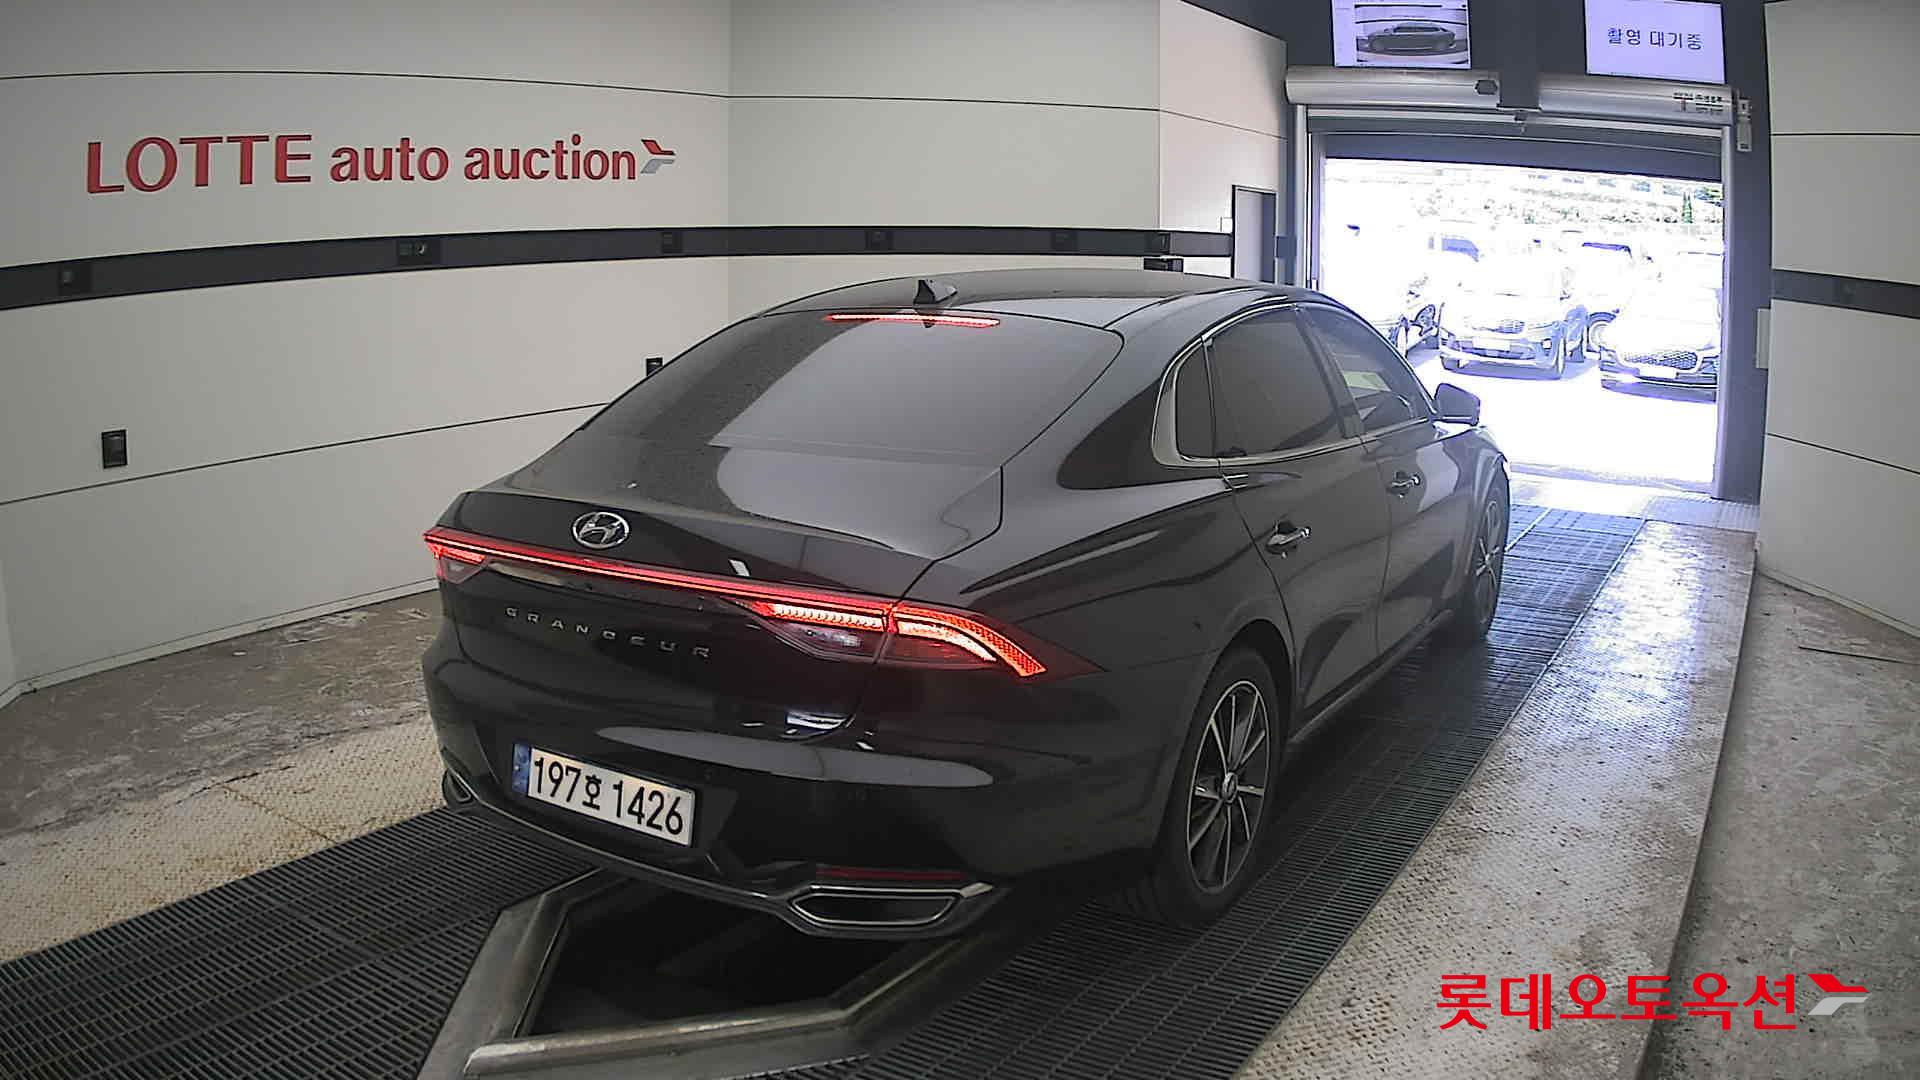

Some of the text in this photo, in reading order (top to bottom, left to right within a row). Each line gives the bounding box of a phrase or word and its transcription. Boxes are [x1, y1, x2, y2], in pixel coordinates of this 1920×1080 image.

[1608, 28, 1641, 46] 촬영
[87, 134, 636, 194] LOTTE auto auction
[506, 606, 710, 658] GRANDEUR
[534, 757, 684, 836] 197호 1426
